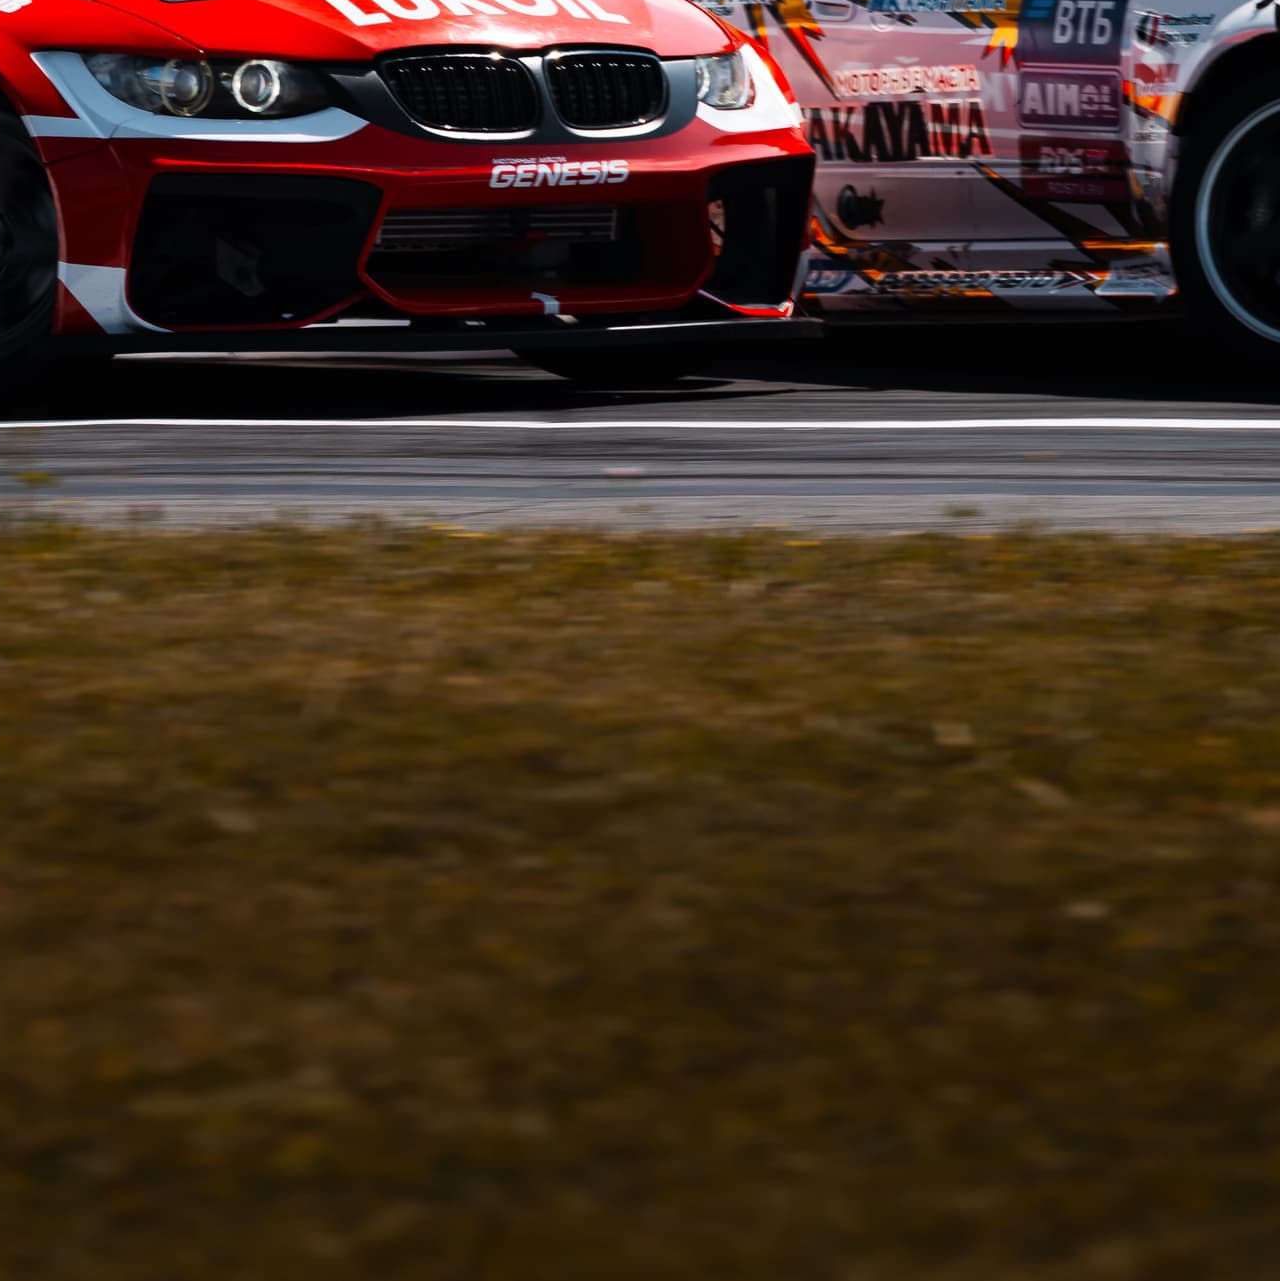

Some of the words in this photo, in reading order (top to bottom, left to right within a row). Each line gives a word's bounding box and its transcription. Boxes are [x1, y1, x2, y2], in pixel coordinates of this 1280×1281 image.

[1053, 0, 1115, 44] ВТБ
[1024, 82, 1118, 116] AIMOL
[800, 100, 992, 162] AKAYAMA
[489, 160, 630, 188] GENESIS
